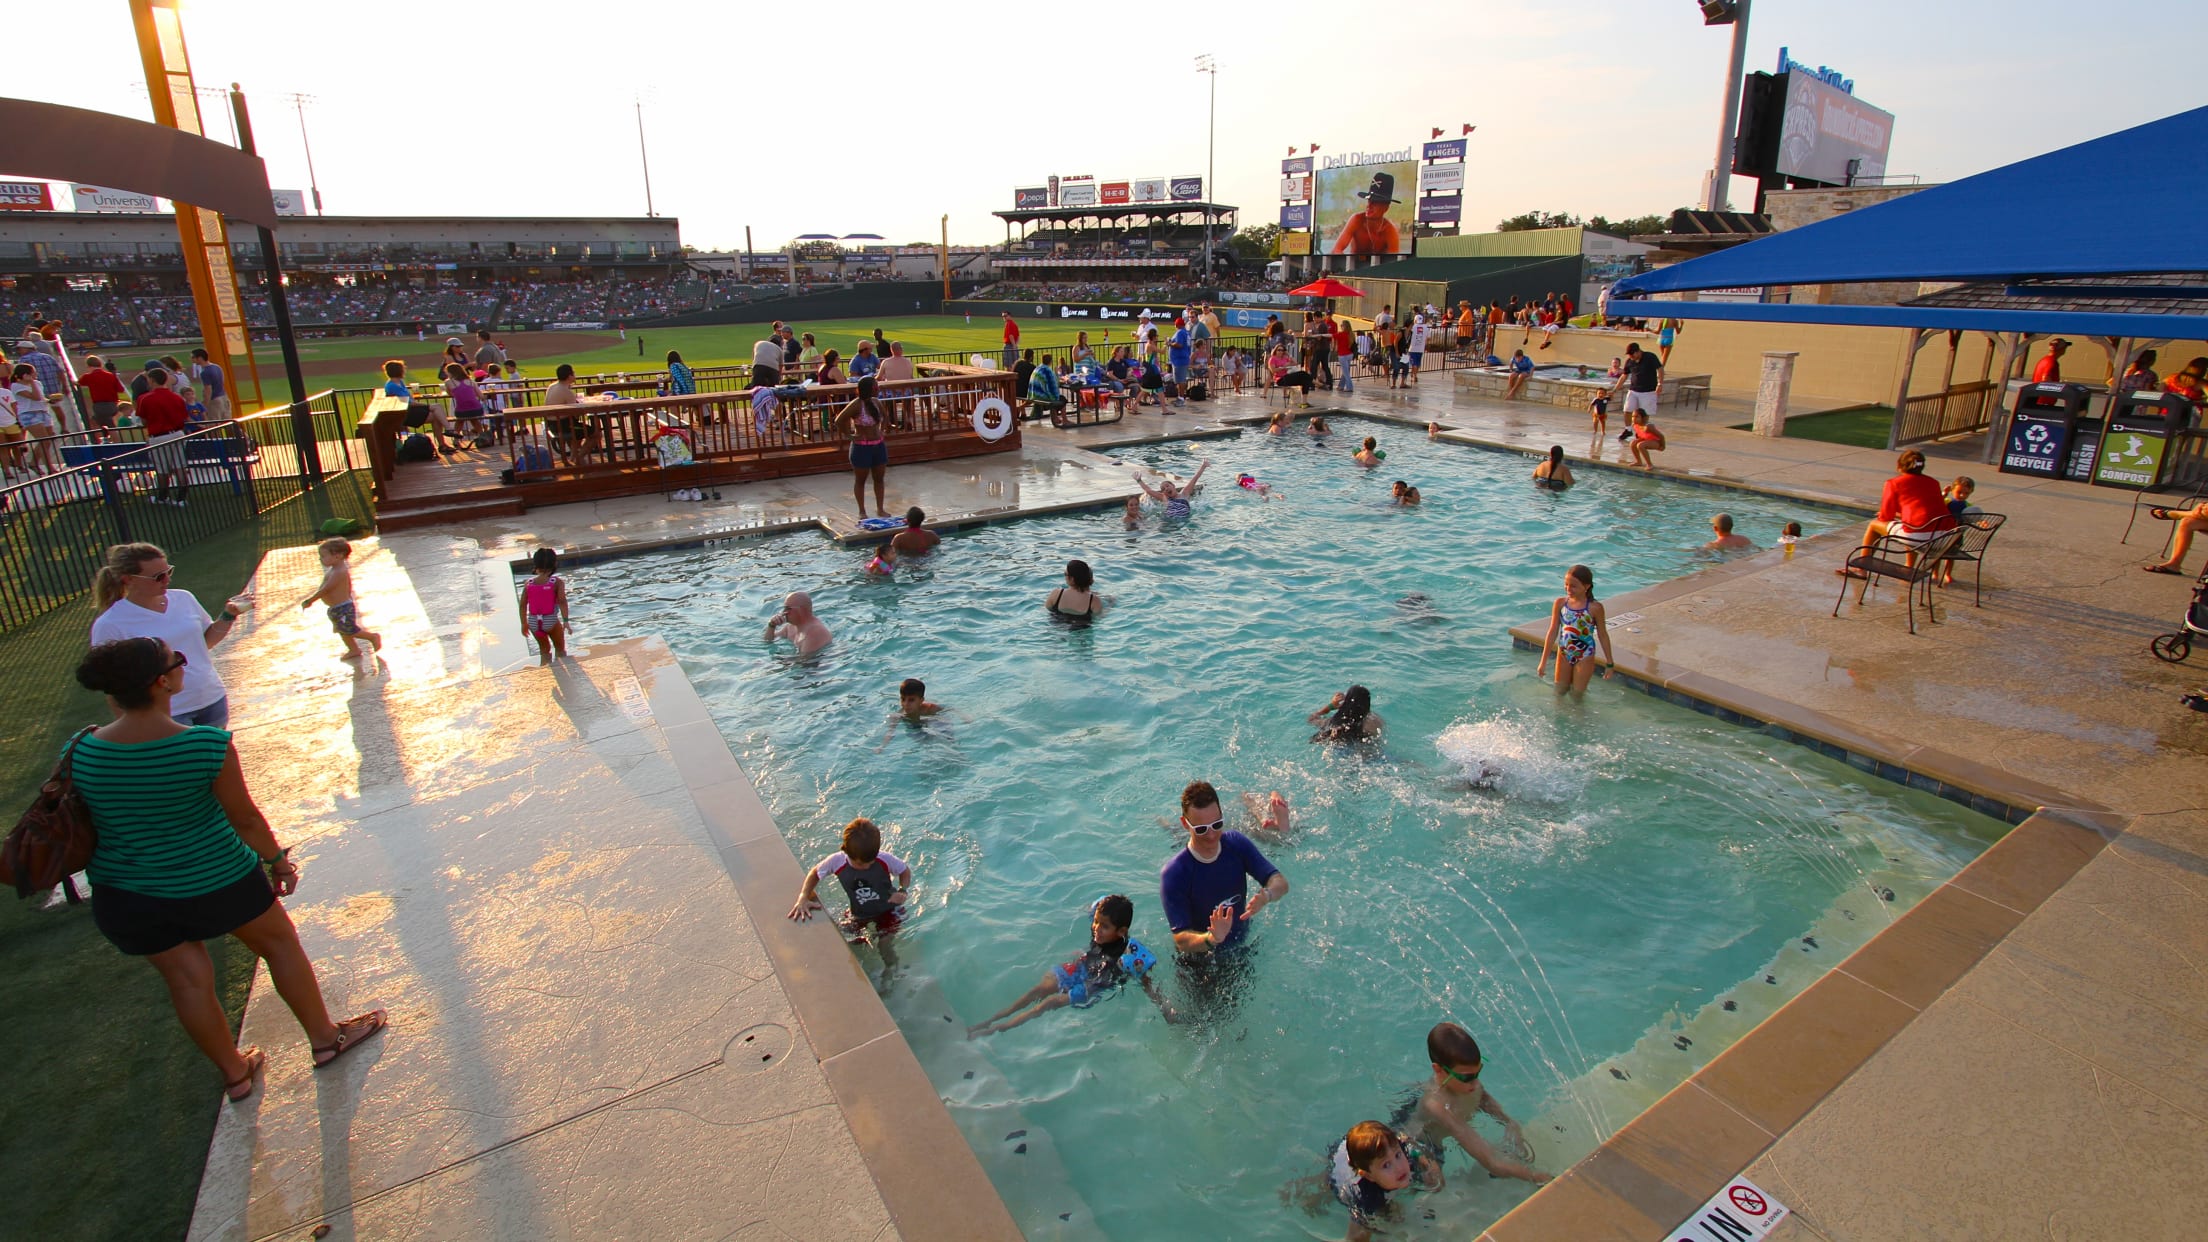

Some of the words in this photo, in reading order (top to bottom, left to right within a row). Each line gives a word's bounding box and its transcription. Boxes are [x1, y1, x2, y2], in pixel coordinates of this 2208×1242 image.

[1323, 153, 1347, 169] Dell
[1350, 145, 1412, 166] Diamond
[1427, 147, 1460, 158] RANGERS
[93, 195, 153, 208] University
[1026, 193, 1045, 203] pepsi
[2005, 456, 2054, 471] RECYCLE
[2075, 444, 2096, 477] TRASH
[2100, 470, 2152, 484] COMPOST
[1698, 1206, 1753, 1242] IN
